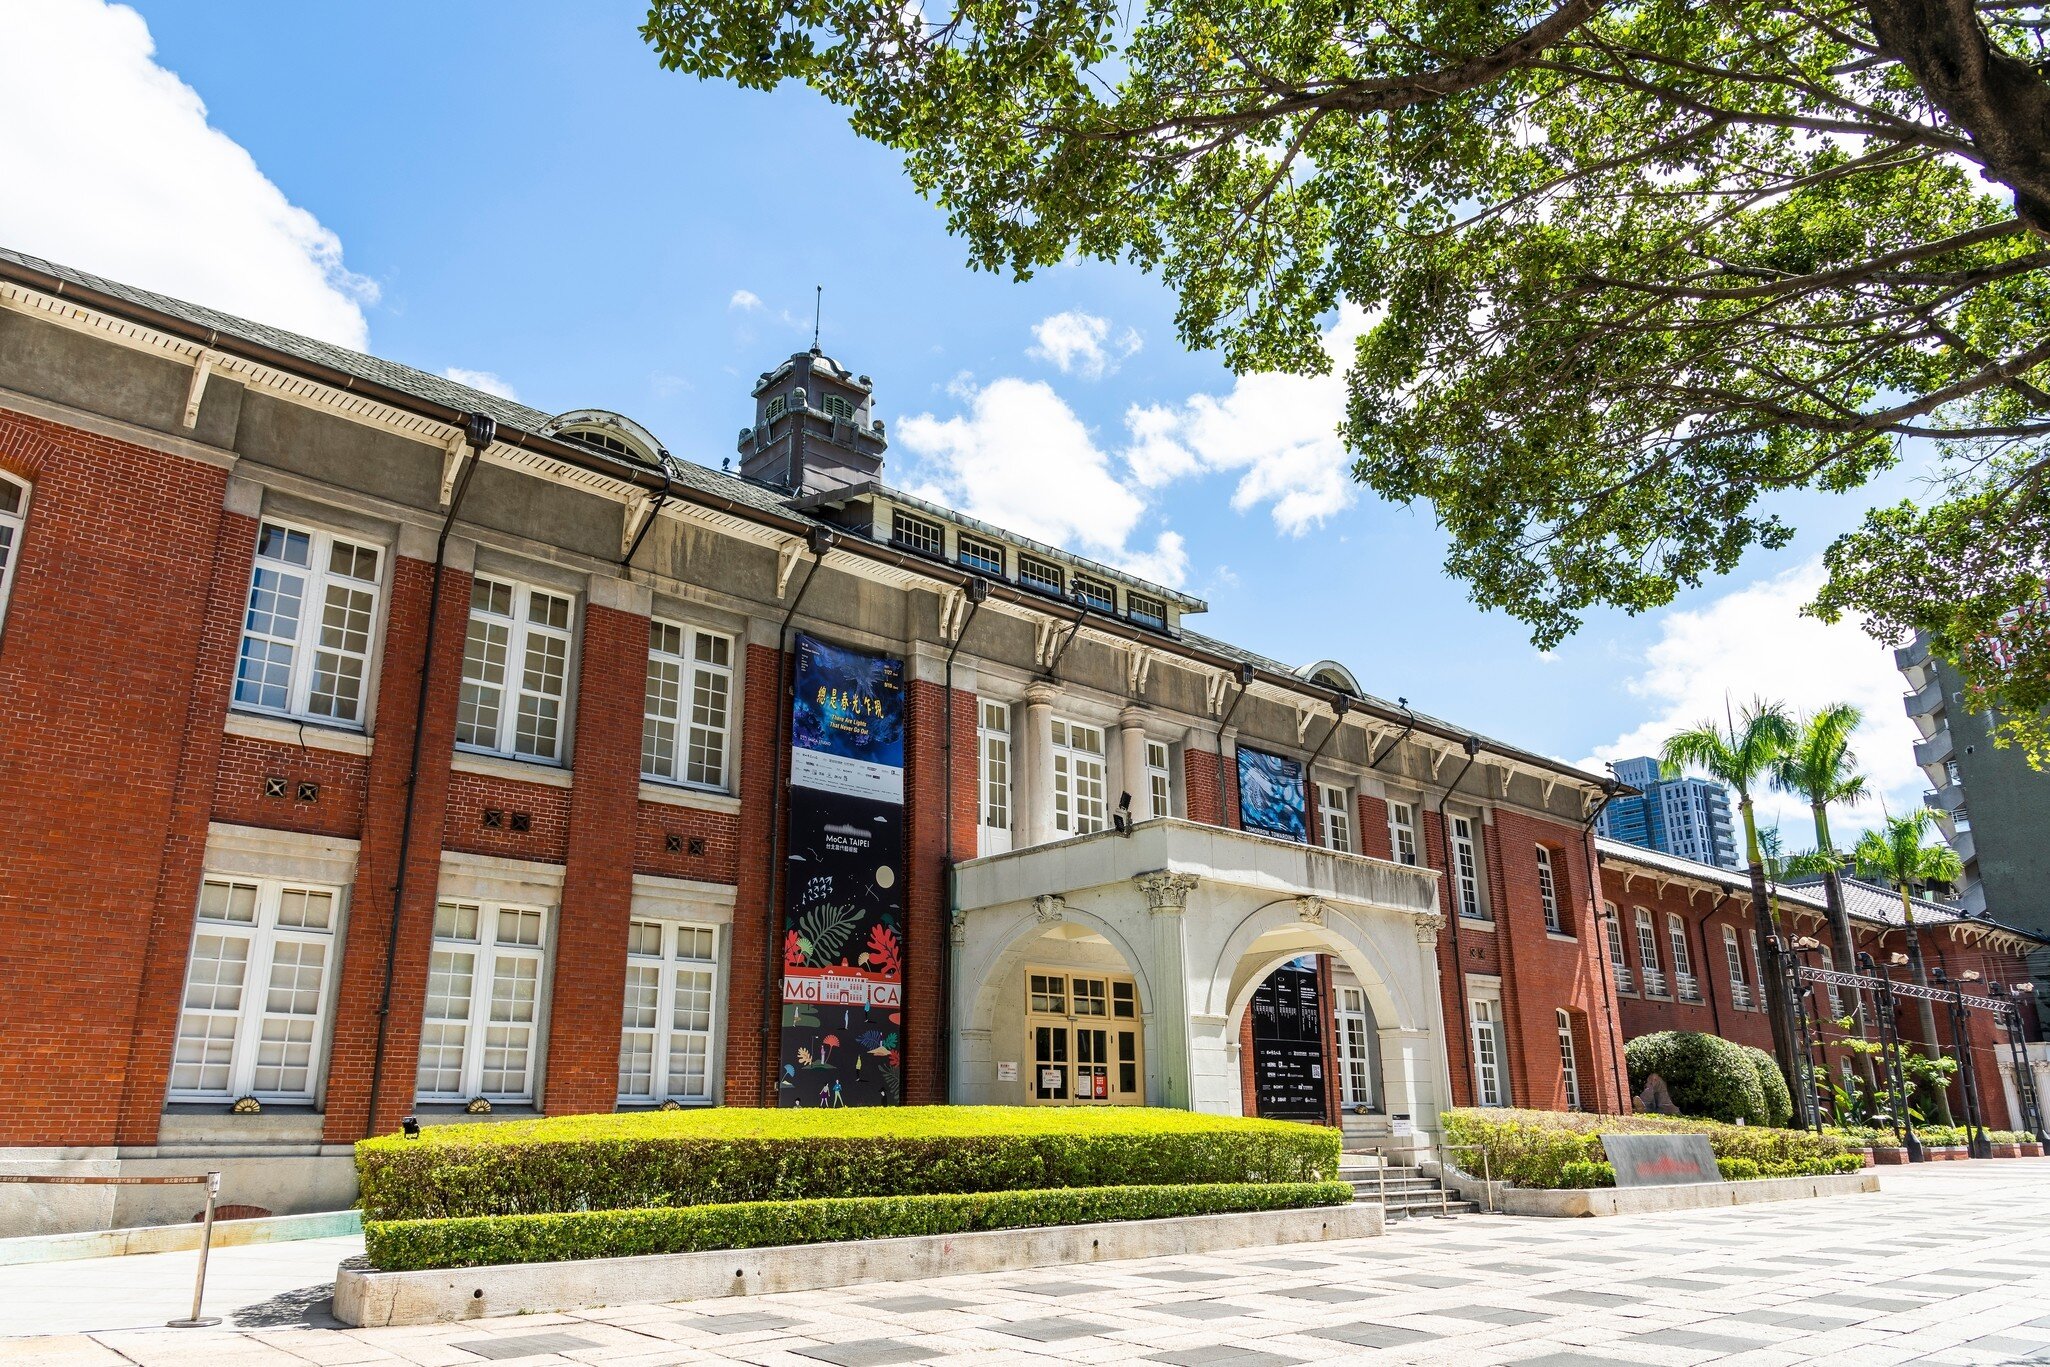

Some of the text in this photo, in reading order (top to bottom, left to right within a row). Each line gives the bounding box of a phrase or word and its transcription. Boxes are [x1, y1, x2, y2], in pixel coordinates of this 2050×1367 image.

[832, 714, 845, 722] There
[853, 720, 867, 728] Lights
[840, 724, 853, 732] Never
[1245, 825, 1270, 837] TOMORROW,
[825, 834, 870, 848] MoCA TAIPEI
